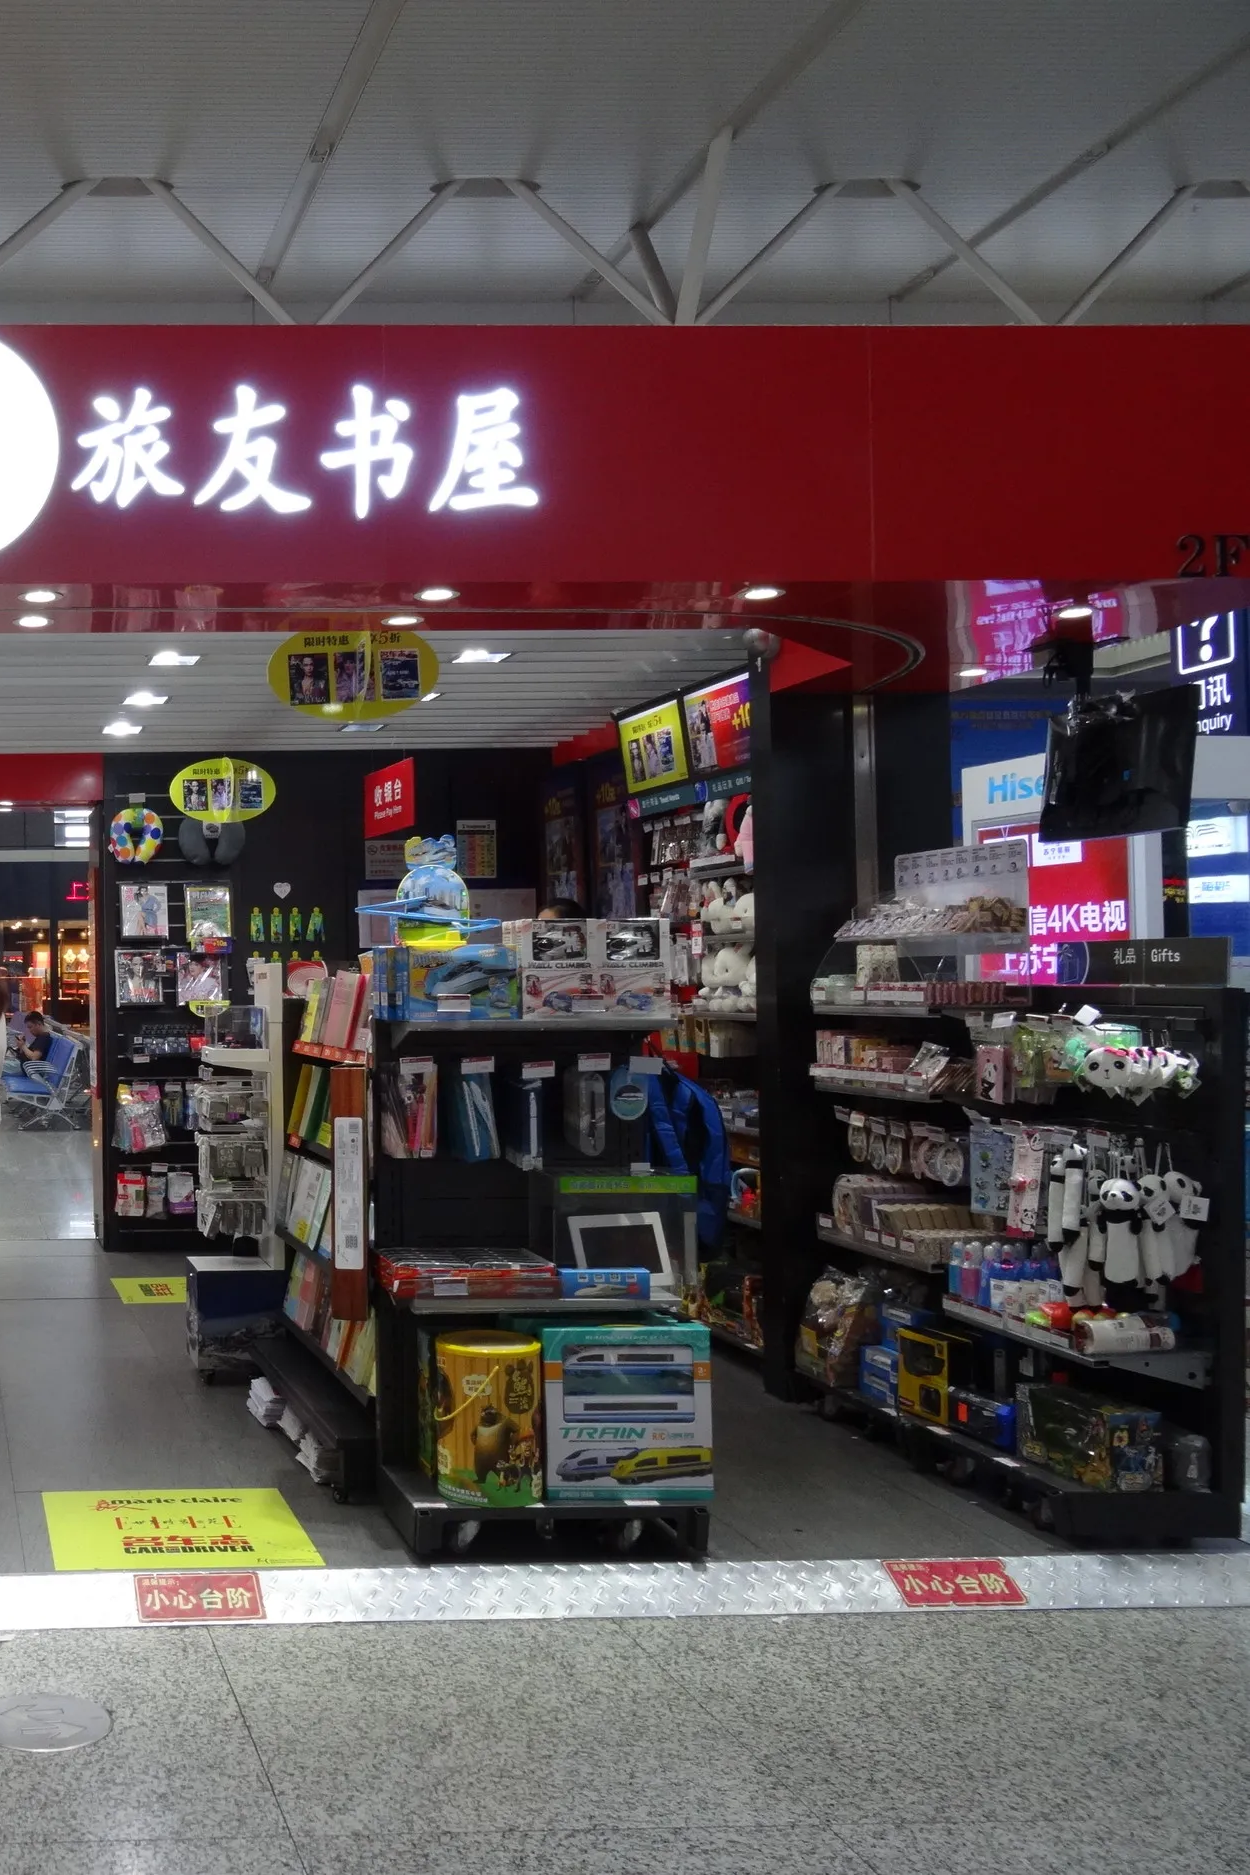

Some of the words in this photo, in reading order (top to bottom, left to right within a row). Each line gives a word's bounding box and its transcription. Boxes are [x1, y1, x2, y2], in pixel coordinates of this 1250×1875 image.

[71, 385, 539, 519] 旅友书屋
[1177, 534, 1250, 578] 2F
[304, 634, 350, 648] 限时特惠
[374, 778, 402, 807] 收银台
[1113, 948, 1136, 965] 礼品
[1151, 949, 1181, 963] Gifts
[559, 1427, 647, 1440] TRAIN
[111, 1497, 176, 1505] marie
[181, 1496, 243, 1504] claire
[122, 1534, 251, 1547] 名车志
[124, 1546, 165, 1555] CAR
[181, 1545, 256, 1554] DRIVER
[904, 1573, 1010, 1595] 小心台阶
[145, 1587, 252, 1611] 小心台阶
